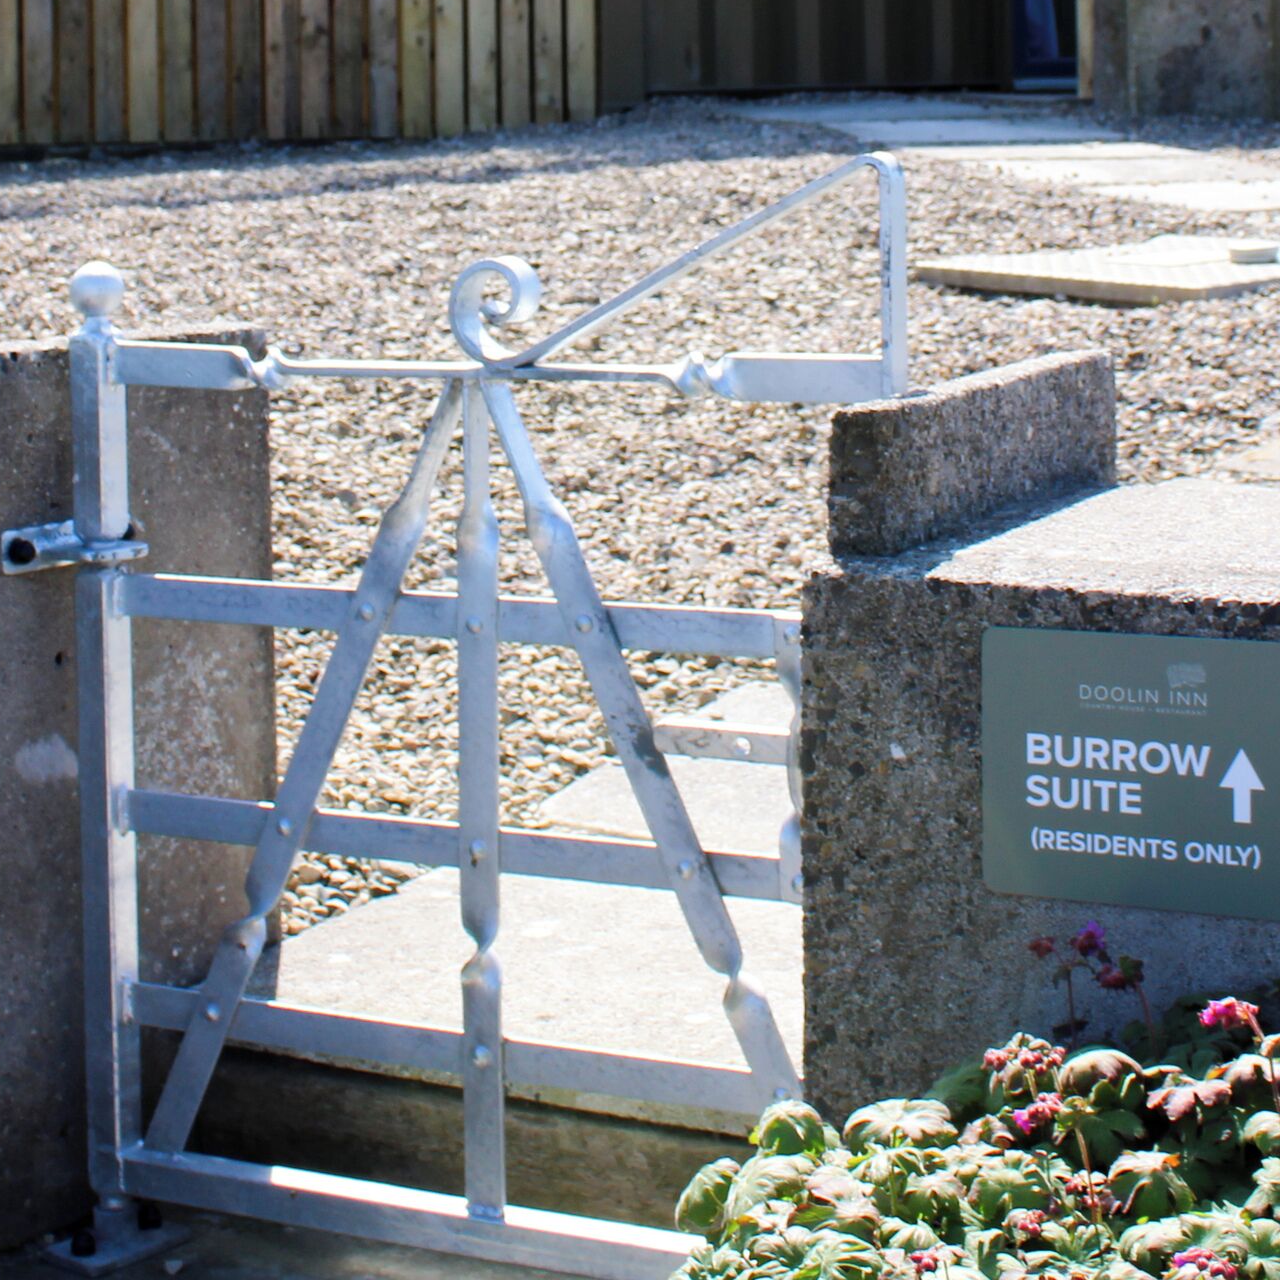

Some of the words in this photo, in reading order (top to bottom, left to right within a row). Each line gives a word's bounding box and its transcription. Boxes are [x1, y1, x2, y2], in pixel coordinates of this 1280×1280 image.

[1079, 684, 1159, 703] DOOLIN
[1169, 690, 1208, 707] INN
[1026, 732, 1211, 777] BURROW
[1026, 775, 1142, 815] SUITE
[1030, 826, 1178, 861] (RESIDENTS
[1185, 841, 1261, 869] ONLY)
